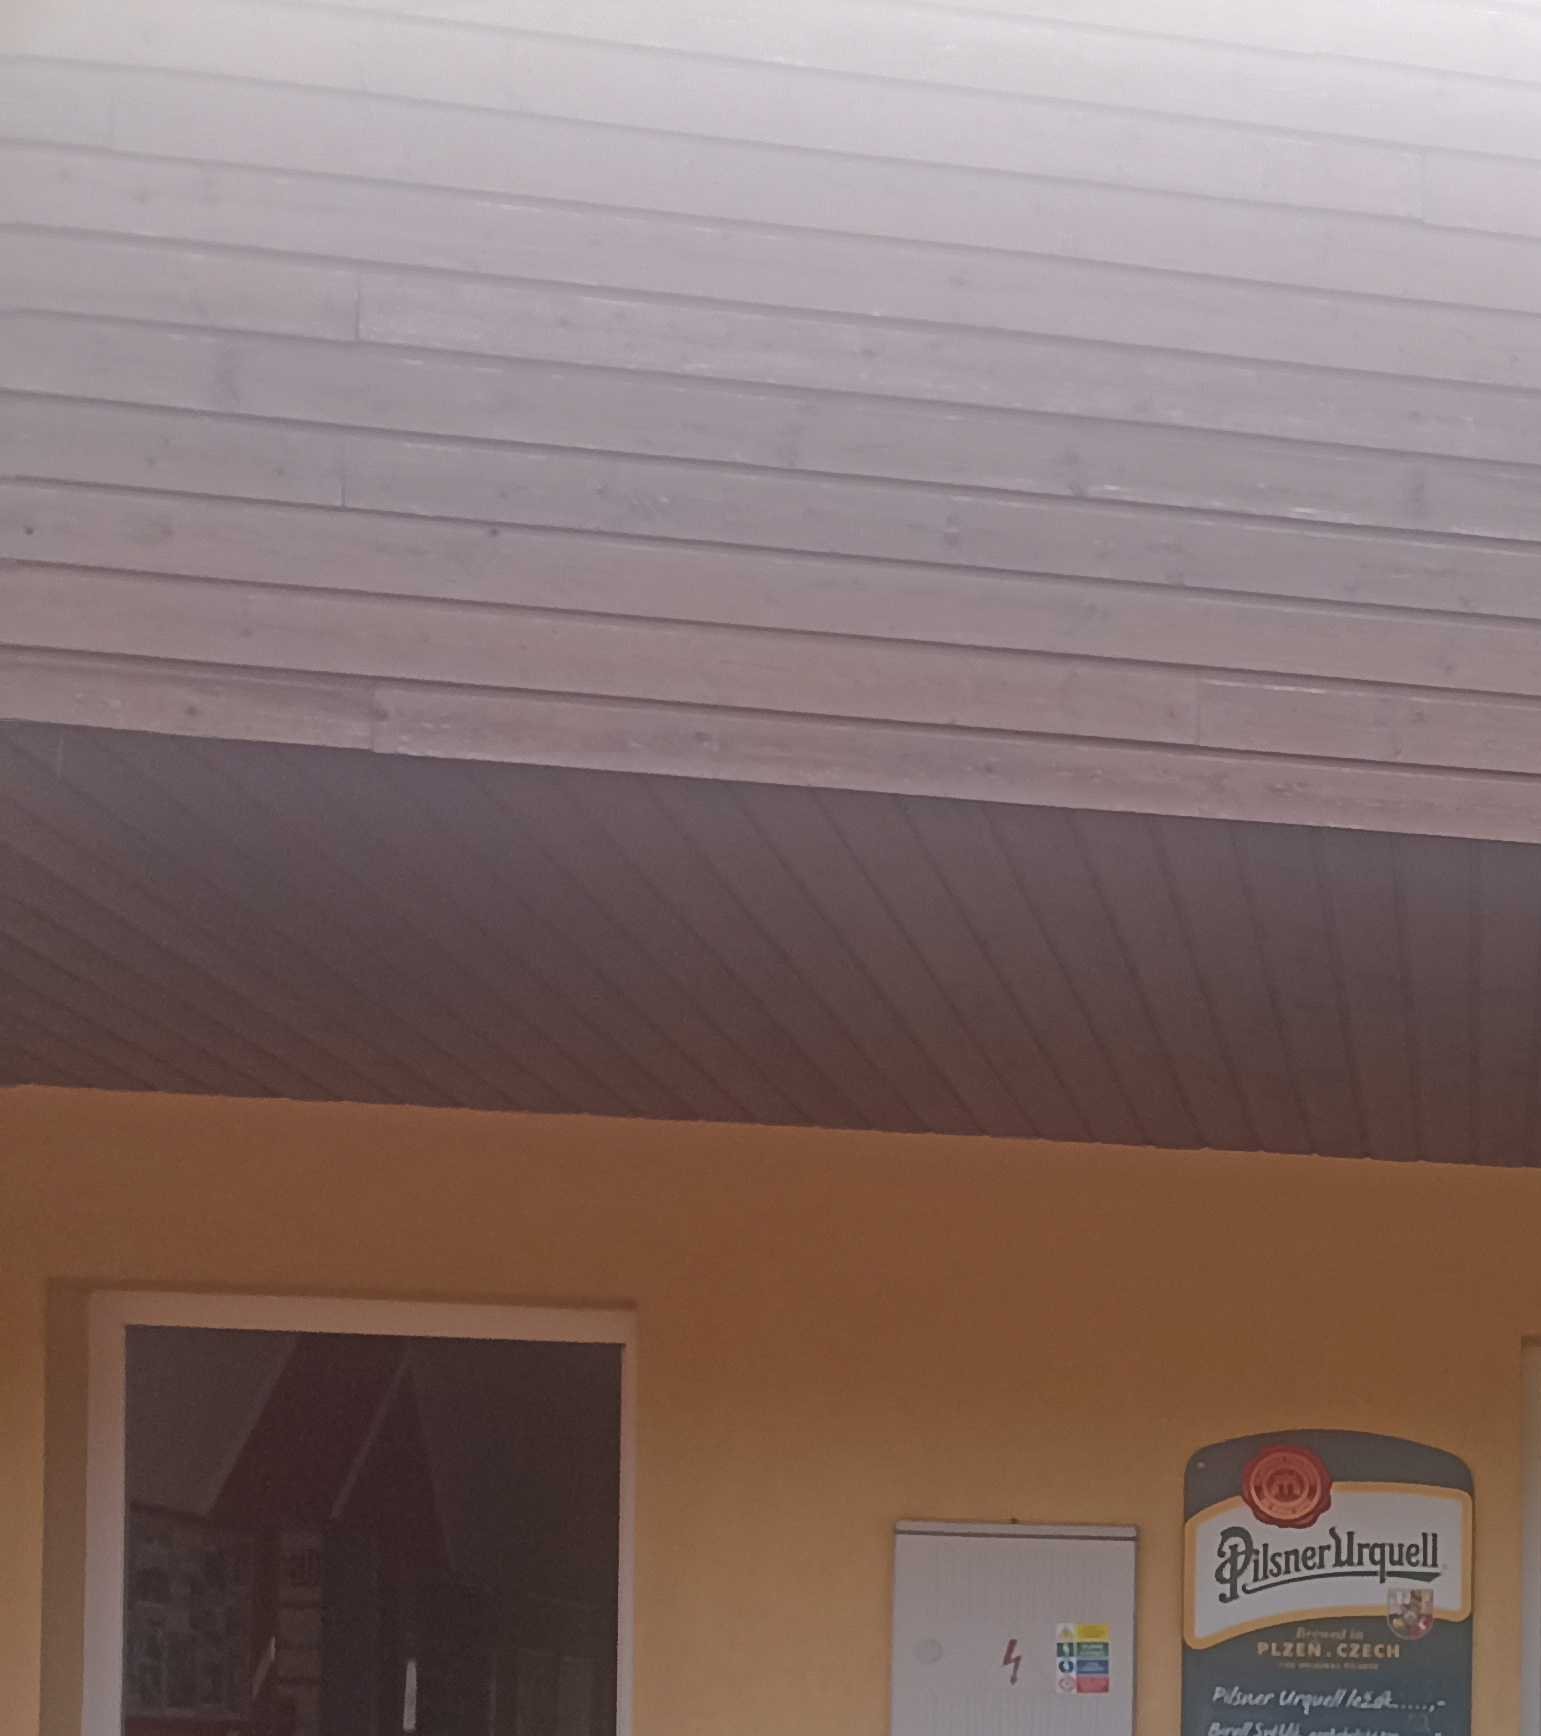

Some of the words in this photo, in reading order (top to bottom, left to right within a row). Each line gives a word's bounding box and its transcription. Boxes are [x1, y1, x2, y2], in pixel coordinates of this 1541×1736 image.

[1214, 1526, 1331, 1603] Pilsner
[1329, 1526, 1438, 1584] Urquell
[1337, 1643, 1400, 1658] CZECH
[1212, 1686, 1275, 1706] Pilsner
